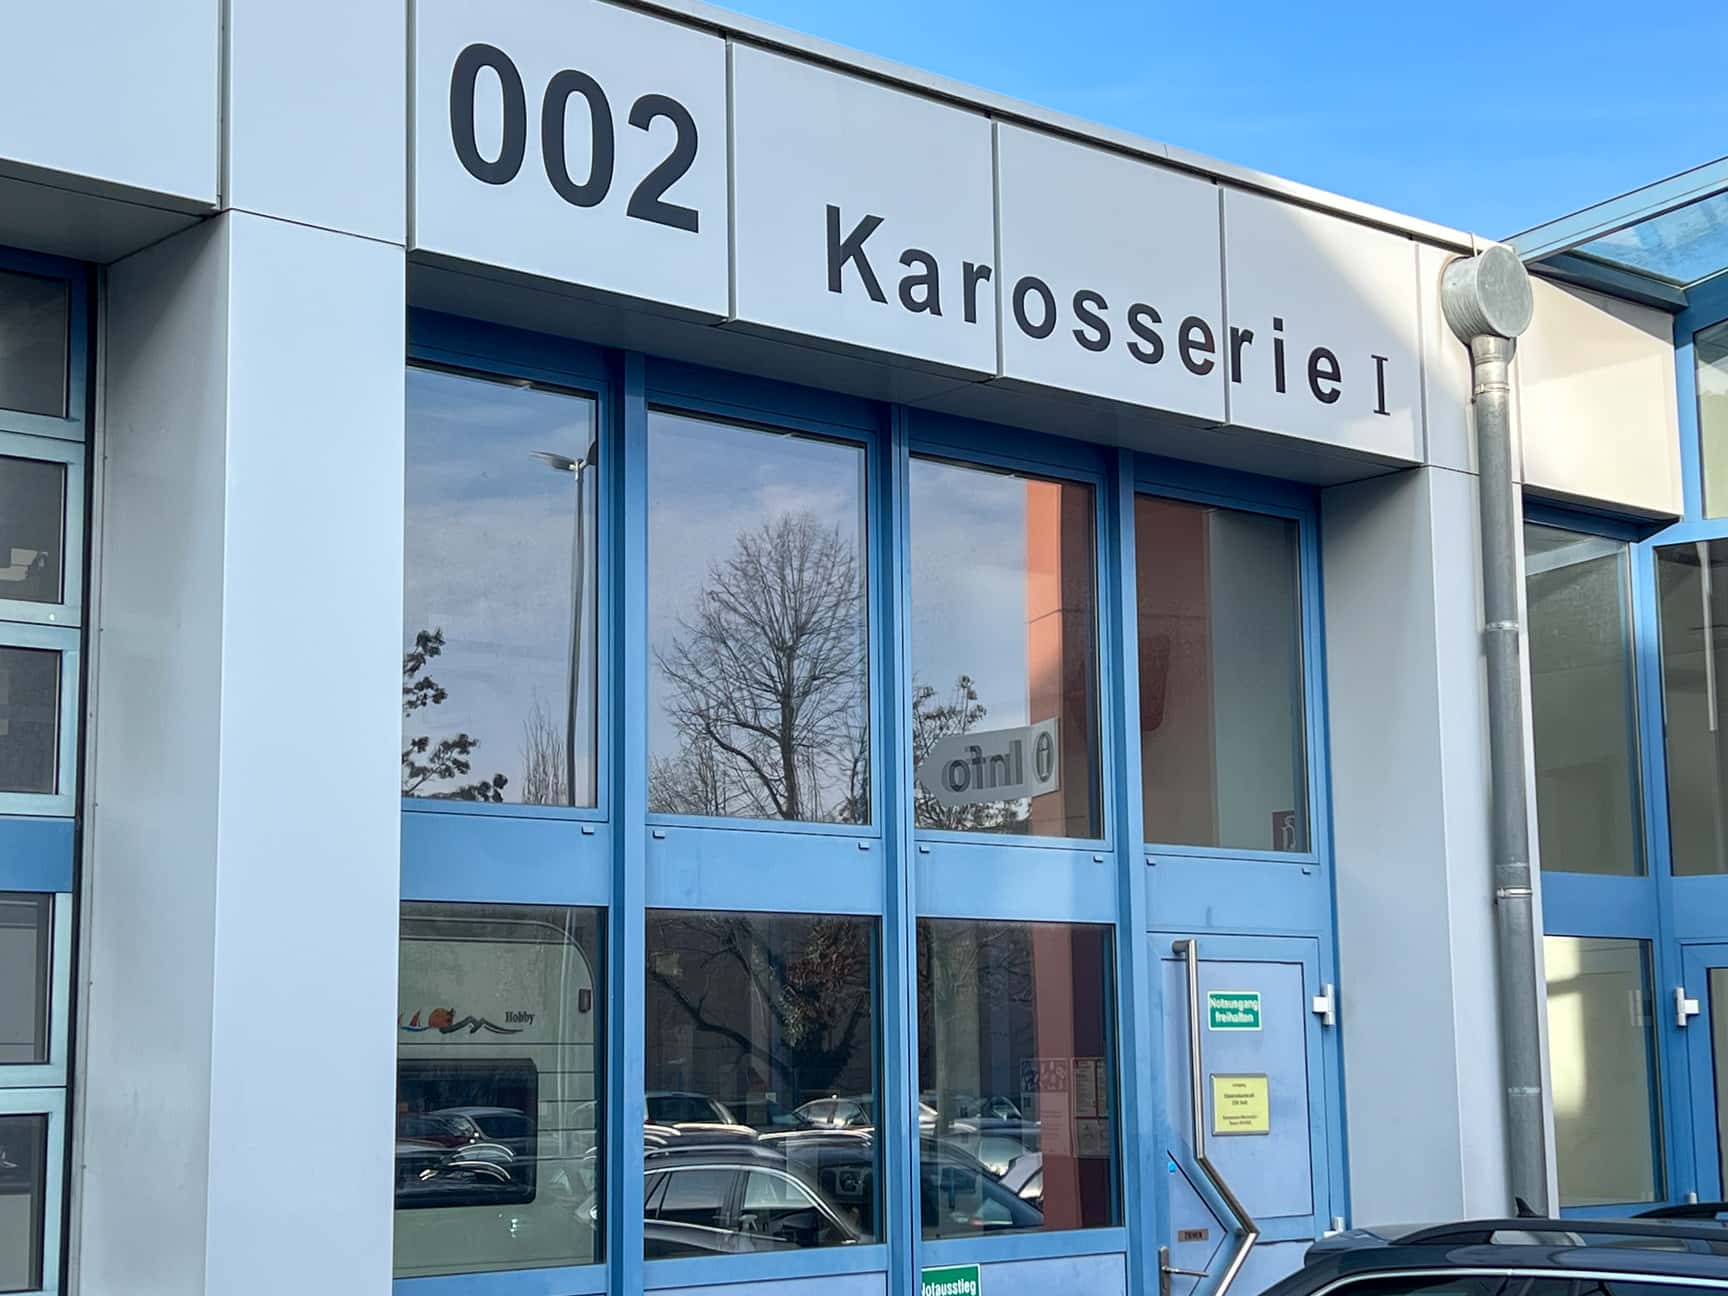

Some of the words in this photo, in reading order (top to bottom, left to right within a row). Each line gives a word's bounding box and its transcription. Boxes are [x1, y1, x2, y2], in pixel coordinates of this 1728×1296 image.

[449, 43, 699, 233] 002
[826, 204, 1342, 405] Karosserie
[1370, 354, 1391, 417] I
[504, 1010, 536, 1026] Hobby
